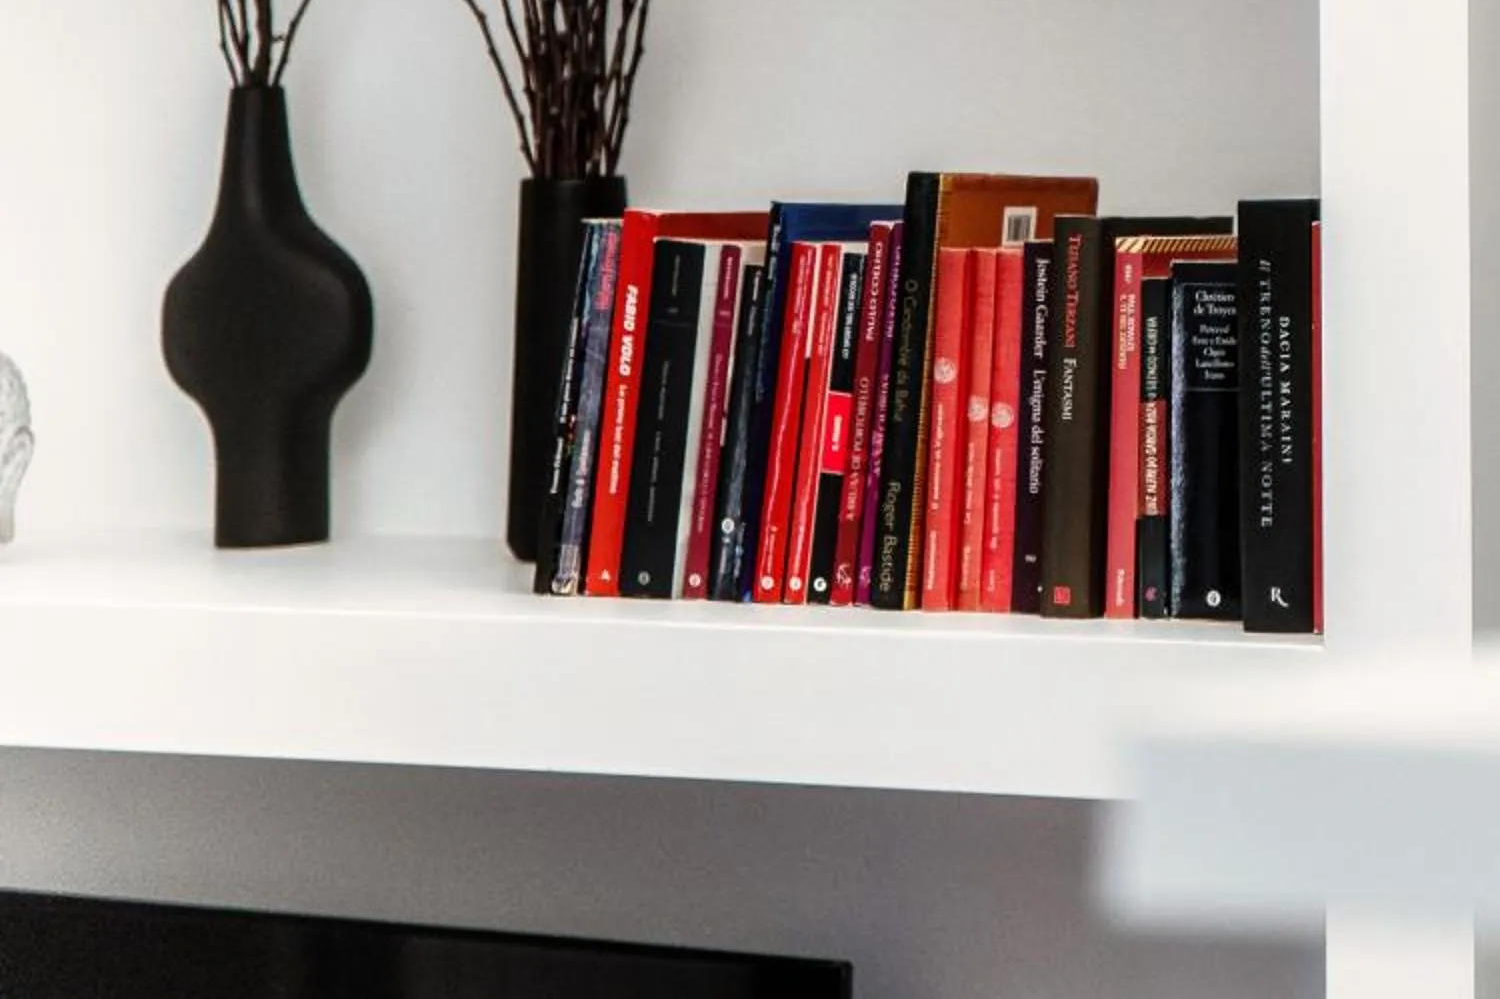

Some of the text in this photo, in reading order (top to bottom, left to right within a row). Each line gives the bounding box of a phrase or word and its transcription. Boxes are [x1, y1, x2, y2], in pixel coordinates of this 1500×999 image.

[619, 284, 639, 377] FABIO VOLO
[865, 240, 883, 342] PAULO COELHO
[1032, 258, 1050, 359] Jostein Gaarder
[1259, 278, 1272, 345] TRENO
[1028, 370, 1047, 494] L'enigma del solitario
[1279, 316, 1293, 465] DACIA MARAINI
[879, 481, 901, 592] Roger Bastide
[1260, 461, 1273, 528] NOTTE
